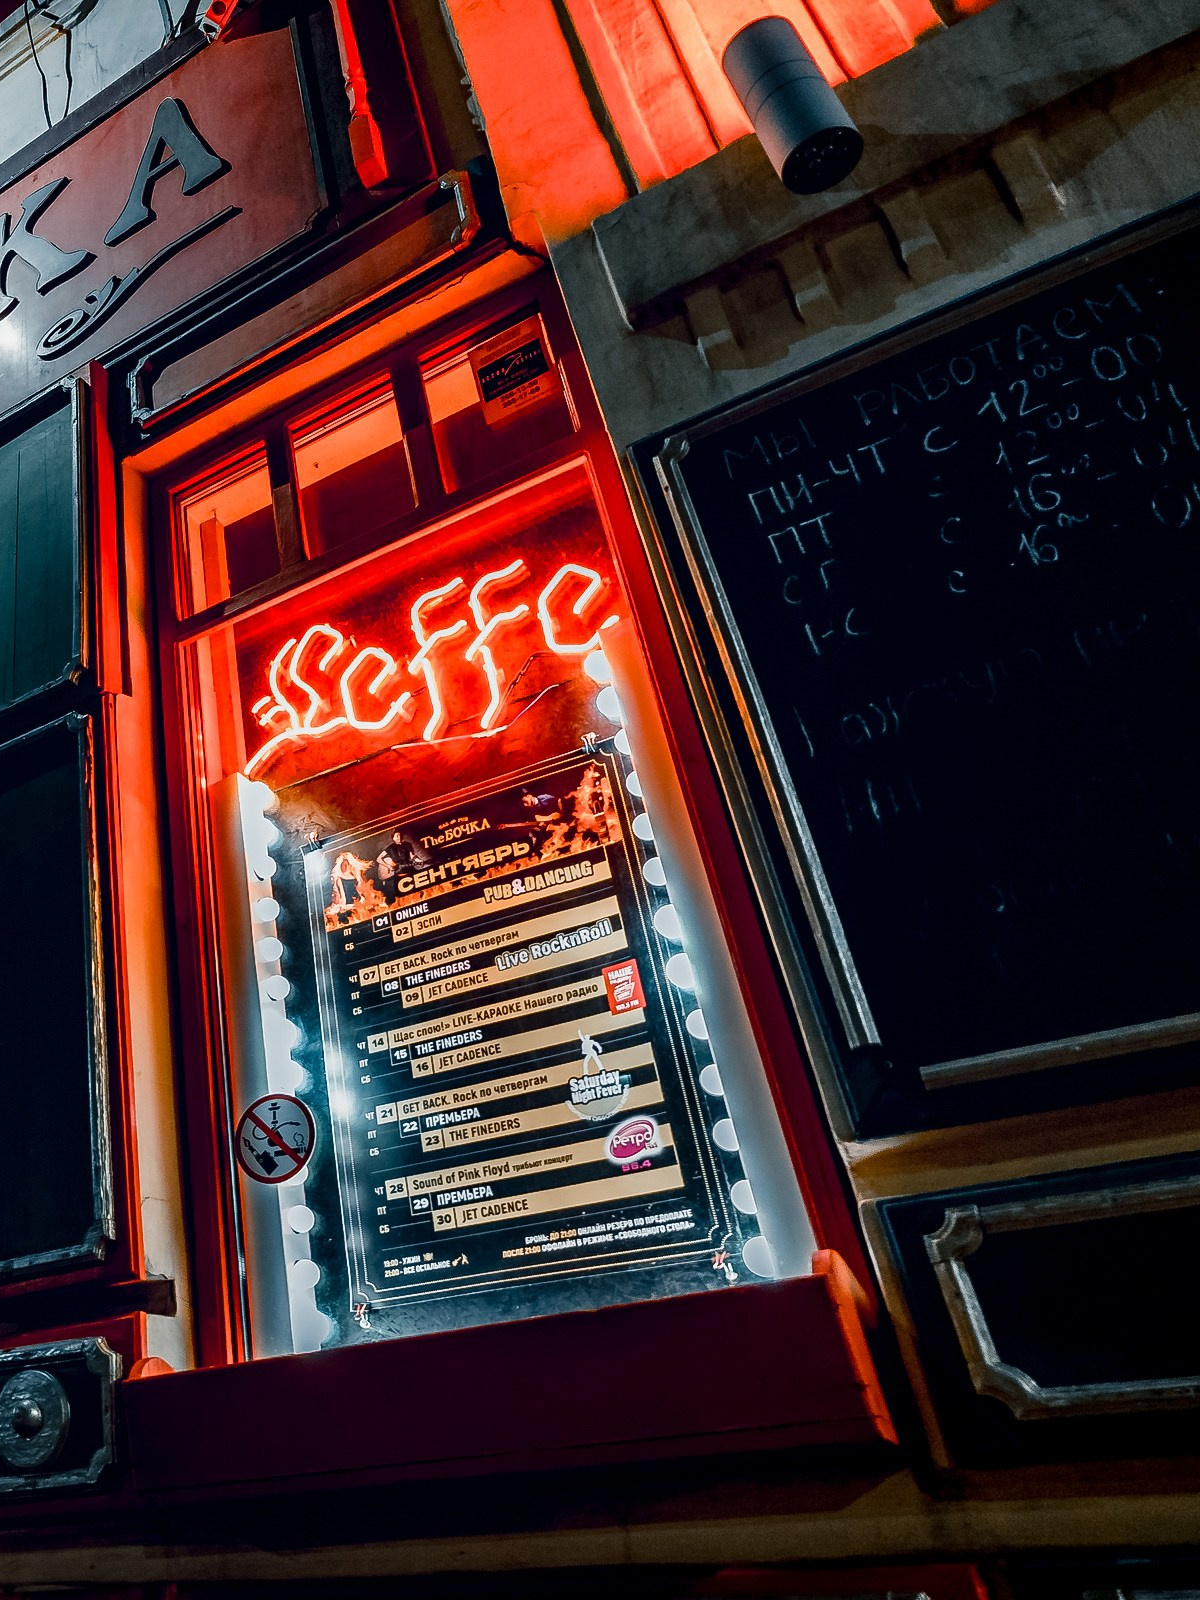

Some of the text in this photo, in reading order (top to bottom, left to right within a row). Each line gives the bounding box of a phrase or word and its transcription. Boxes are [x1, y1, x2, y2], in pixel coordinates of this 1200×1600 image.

[723, 418, 818, 480] МЫ
[767, 511, 834, 564] ПТ
[247, 560, 620, 775] Leffe
[420, 834, 445, 849] The
[444, 818, 491, 842] БОЧКА
[397, 840, 531, 893] СЕНТЯБРЬ
[484, 860, 594, 903] PUB&DANCING
[343, 902, 430, 937] ПТ 01 ONLINE
[344, 942, 355, 951] СБ
[395, 927, 410, 938] 02
[348, 930, 520, 983] ЧТ 07 GET BACK. Rock по четвергам
[495, 918, 612, 972] Live RocknRoll
[351, 959, 471, 1000] ПТ 08 THE FINEDERS
[352, 972, 489, 1016] СБ 09 JET CADENCE
[357, 1041, 367, 1050] ЧТ
[370, 1037, 385, 1047] 14
[393, 1029, 415, 1044] Щас
[416, 1021, 451, 1038] спою!»
[452, 998, 522, 1028] LIVE-КАРАОКЕ
[524, 992, 564, 1011] Нашего
[566, 984, 599, 1002] радио
[359, 1030, 483, 1068] ПТ 15 THE FINEDERS
[360, 1043, 501, 1085] СБ 16 JET CADENCE
[365, 1074, 548, 1121] ЧТ 21 GET BACK. Rock по четвергам
[569, 1070, 620, 1092] Saturday
[571, 1084, 622, 1104] Night Fever
[367, 1107, 481, 1140] ПТ 22 ПРЕМЬЕРА
[369, 1117, 521, 1157] СБ 23 THE FINEDERS
[374, 1153, 574, 1196] ЧТ 28 Sound of Pink Floyd трибьют концерт
[621, 1159, 652, 1172] 96.4
[377, 1186, 494, 1216] ПТ 29 ПРЕМЬЕРА
[379, 1199, 529, 1234] СБ 30 JET CADENCE
[502, 1248, 524, 1259] ПОСЛЕ
[524, 1245, 541, 1255] 21:00
[542, 1239, 576, 1253] ОФФЛАЙН
[583, 1232, 614, 1246] РЕЖИМЕ
[614, 1225, 666, 1241] «СВОБОДНОГО
[666, 1219, 696, 1233] СТОЛА»
[549, 1232, 560, 1242] ДО
[560, 1228, 577, 1239] 21:00
[577, 1223, 606, 1236] ОНЛАЙН
[606, 1219, 633, 1233] РЕЗЕРВ
[633, 1217, 644, 1227] ПО
[645, 1209, 693, 1225] ПРЕДОПЛАТЕ
[402, 1254, 421, 1265] УЖИН
[403, 1266, 416, 1275] ВСЕ
[415, 1260, 451, 1273] ОСТАЛЬНОЕ
